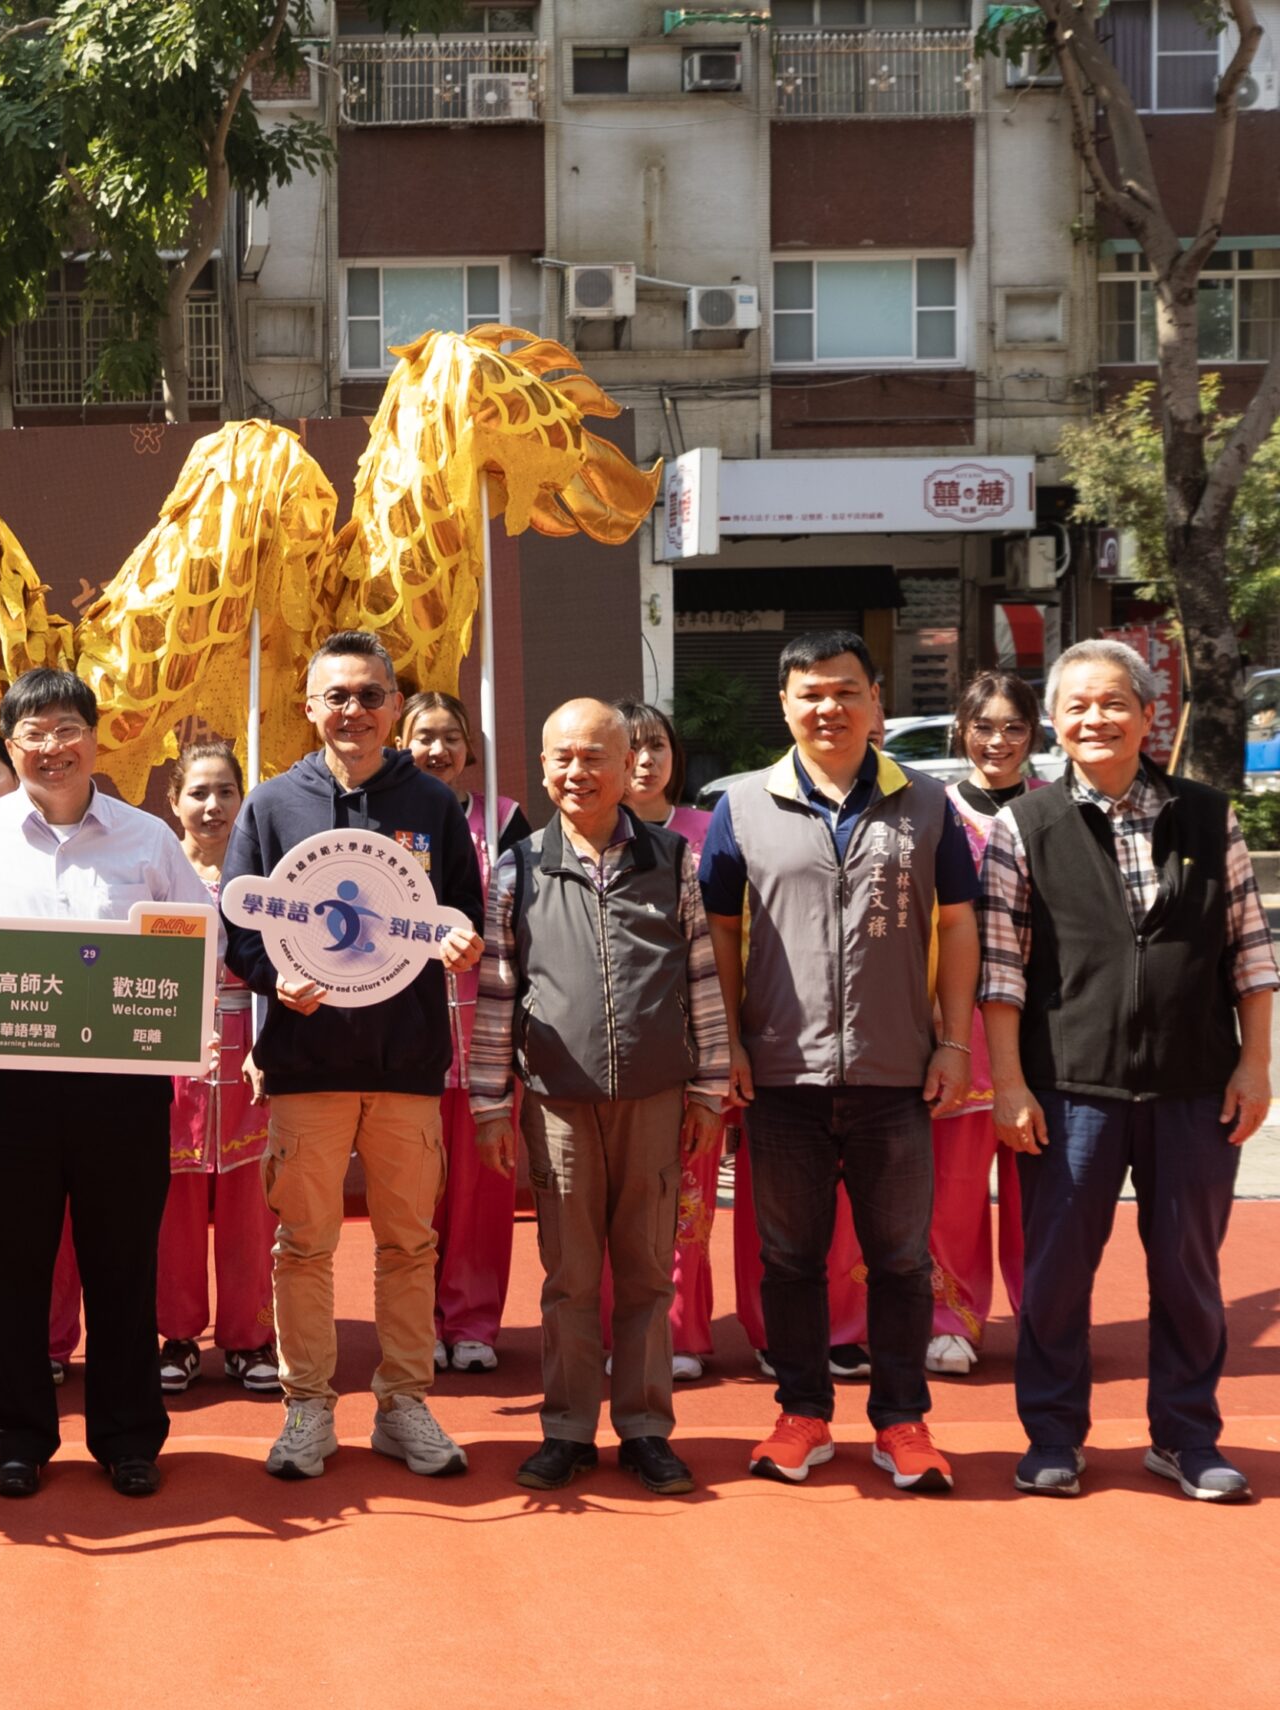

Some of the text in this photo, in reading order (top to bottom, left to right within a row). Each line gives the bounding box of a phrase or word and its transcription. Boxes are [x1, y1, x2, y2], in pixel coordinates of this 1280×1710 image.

[872, 821, 890, 856] 里長
[898, 817, 915, 868] 苓雅區
[286, 842, 421, 902] 高雄師範大學語文教學中心
[242, 893, 312, 923] 學華語
[83, 949, 96, 959] 29
[279, 938, 410, 993] Center of Lanuage and Culture Teaching
[113, 976, 179, 1000] 歡迎你
[10, 1000, 49, 1012] NKNU
[112, 1003, 177, 1017] Welcome!
[0, 1022, 57, 1039] 華語學習
[81, 1027, 92, 1043] 0
[132, 1028, 162, 1044] 距離
[28, 1040, 60, 1048] Mandarin
